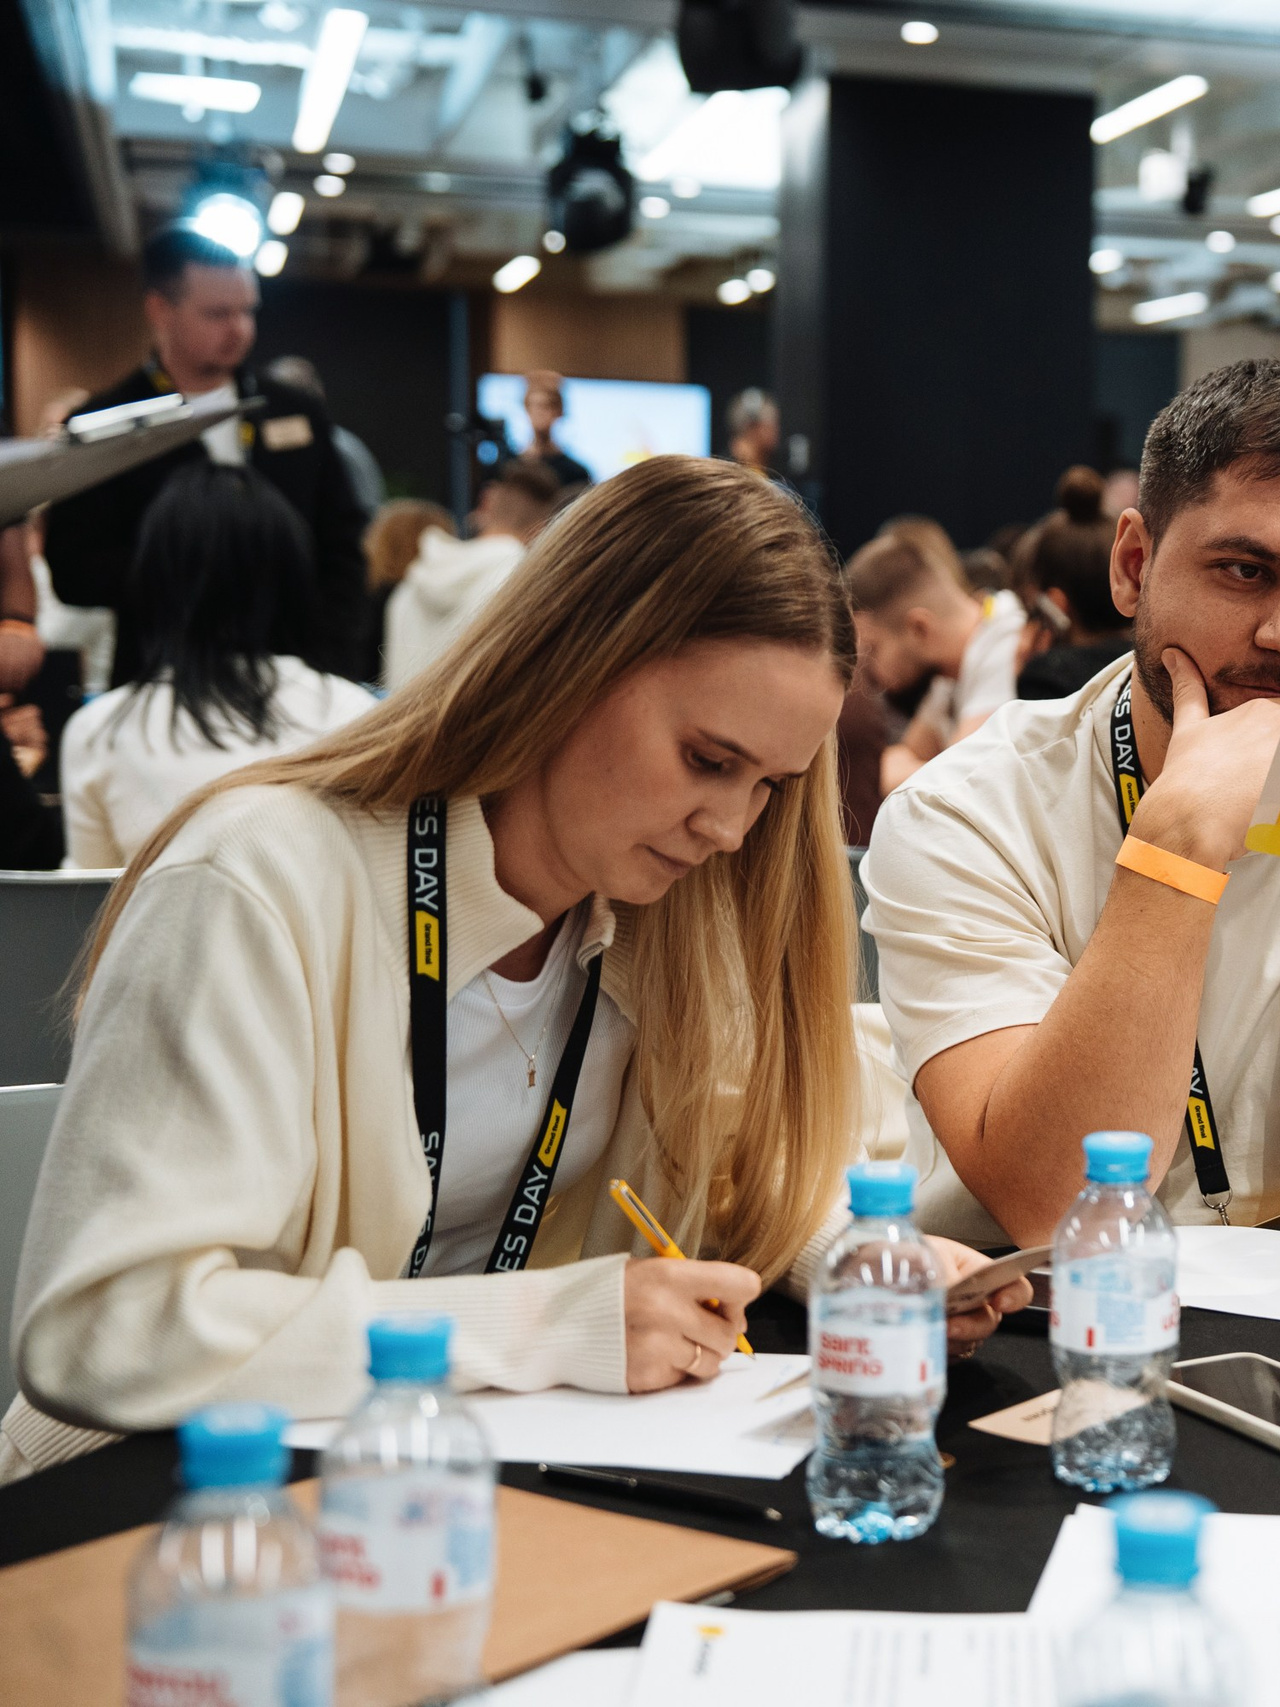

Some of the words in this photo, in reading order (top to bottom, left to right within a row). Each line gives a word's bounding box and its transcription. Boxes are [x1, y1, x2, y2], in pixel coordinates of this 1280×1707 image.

[1115, 724, 1135, 772] DAY
[414, 848, 439, 911] DAY
[1194, 1105, 1204, 1125] Grand
[1199, 1124, 1207, 1139] final
[513, 1164, 549, 1225] DAY
